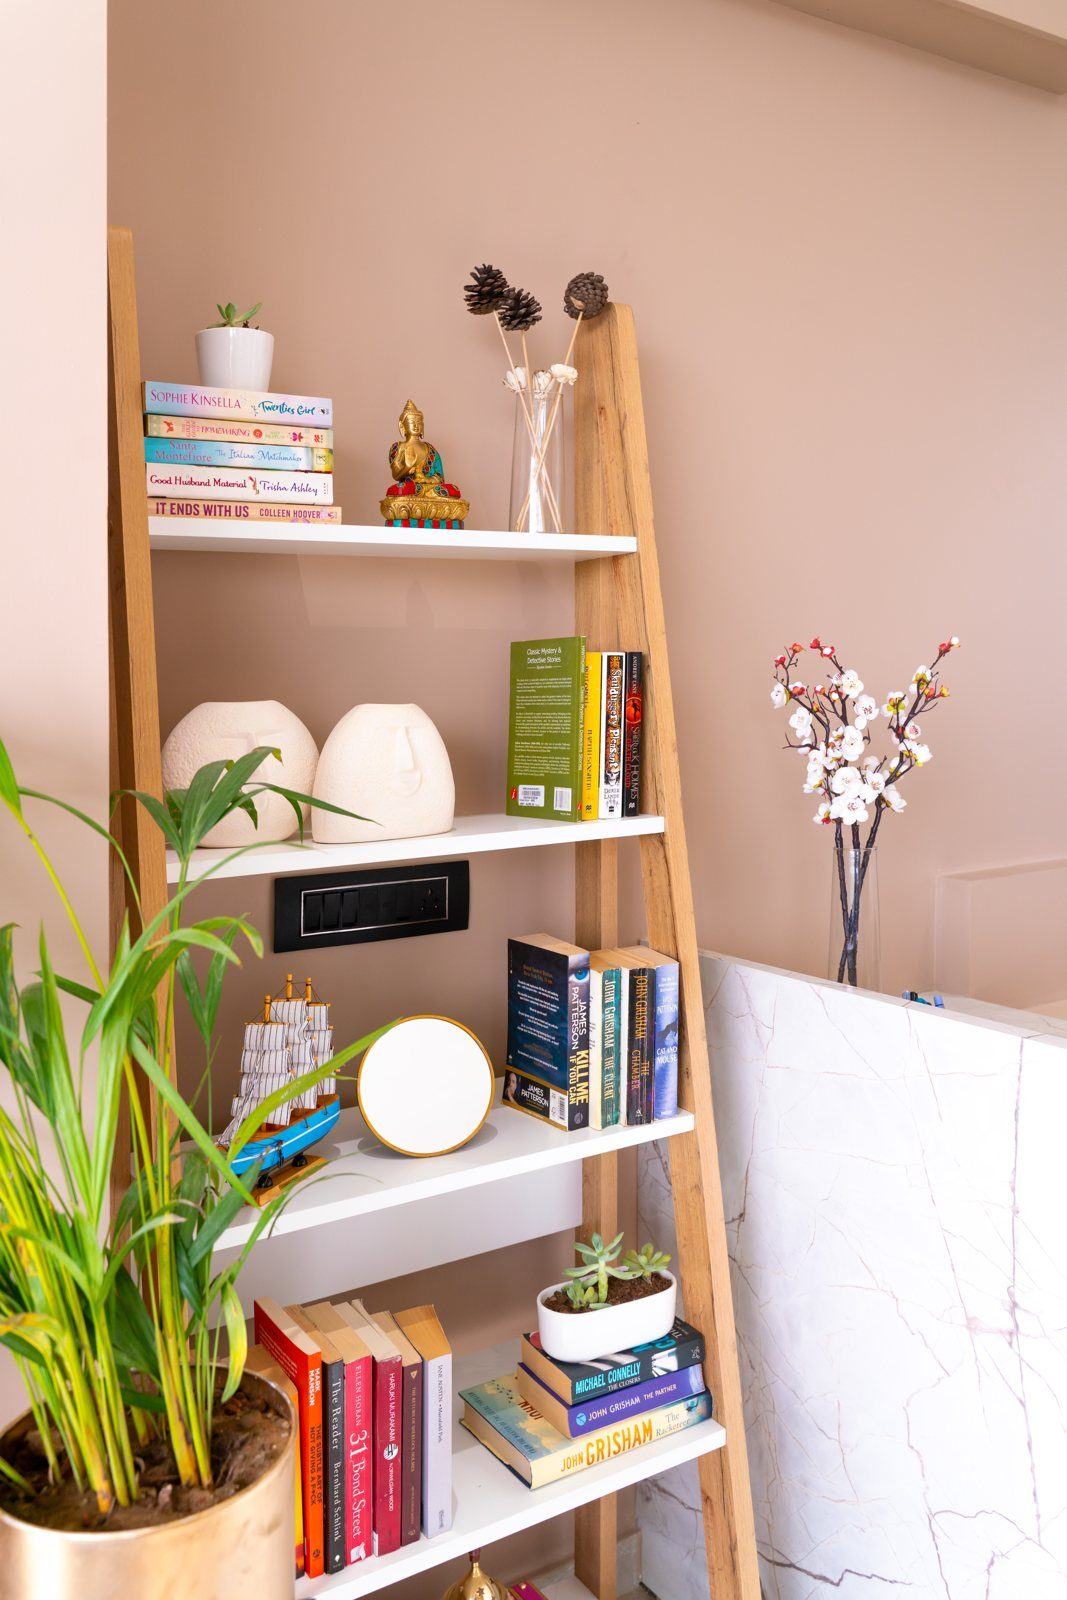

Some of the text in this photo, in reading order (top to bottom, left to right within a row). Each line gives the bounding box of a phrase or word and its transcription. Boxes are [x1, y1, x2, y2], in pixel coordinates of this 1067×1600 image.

[151, 390, 241, 409] SOPHIE KINSELLA
[258, 400, 294, 414] Twenties
[297, 405, 316, 415] Girl
[169, 440, 197, 450] Santa
[228, 448, 255, 460] Italian
[258, 450, 303, 462] Matchmaker
[150, 475, 247, 488] Good Husband Material
[260, 480, 318, 496] Trisha Ashley
[156, 502, 249, 518] IT ENDS WITH US
[260, 508, 320, 518] COLLEEN HOOVER
[541, 648, 557, 656] Mystery
[608, 668, 622, 726] Skulduggery
[608, 730, 620, 770] Pleasant
[633, 976, 648, 1040] JOHN GRISHAM
[579, 999, 587, 1035] JAMES
[604, 979, 616, 1100] JOHN GRISHAM THE CLIENT
[667, 1046, 678, 1054] AND
[569, 1055, 577, 1064] IF
[657, 1055, 678, 1064] MOUSE
[632, 1050, 640, 1090] CHAMBER
[641, 1061, 650, 1076] THE
[576, 1050, 589, 1106] KILL ME
[521, 1089, 549, 1107] PATTERSON
[528, 1084, 544, 1097] JAMES
[576, 1362, 641, 1394] MICHAEL CONNELLY
[608, 1377, 640, 1392] THE CLOSERS
[588, 1408, 608, 1422] JOHN
[609, 1396, 640, 1413] GRISHAM
[655, 1384, 677, 1396] PARTNER
[332, 1378, 342, 1450] The Reader
[665, 1412, 680, 1423] The
[656, 1419, 689, 1437] Racketeer
[560, 1418, 653, 1472] JOHN GRISHAM
[334, 1462, 342, 1506] Bernhard
[350, 1429, 368, 1539] 31 Bond Street
[317, 1494, 322, 1504] OF
